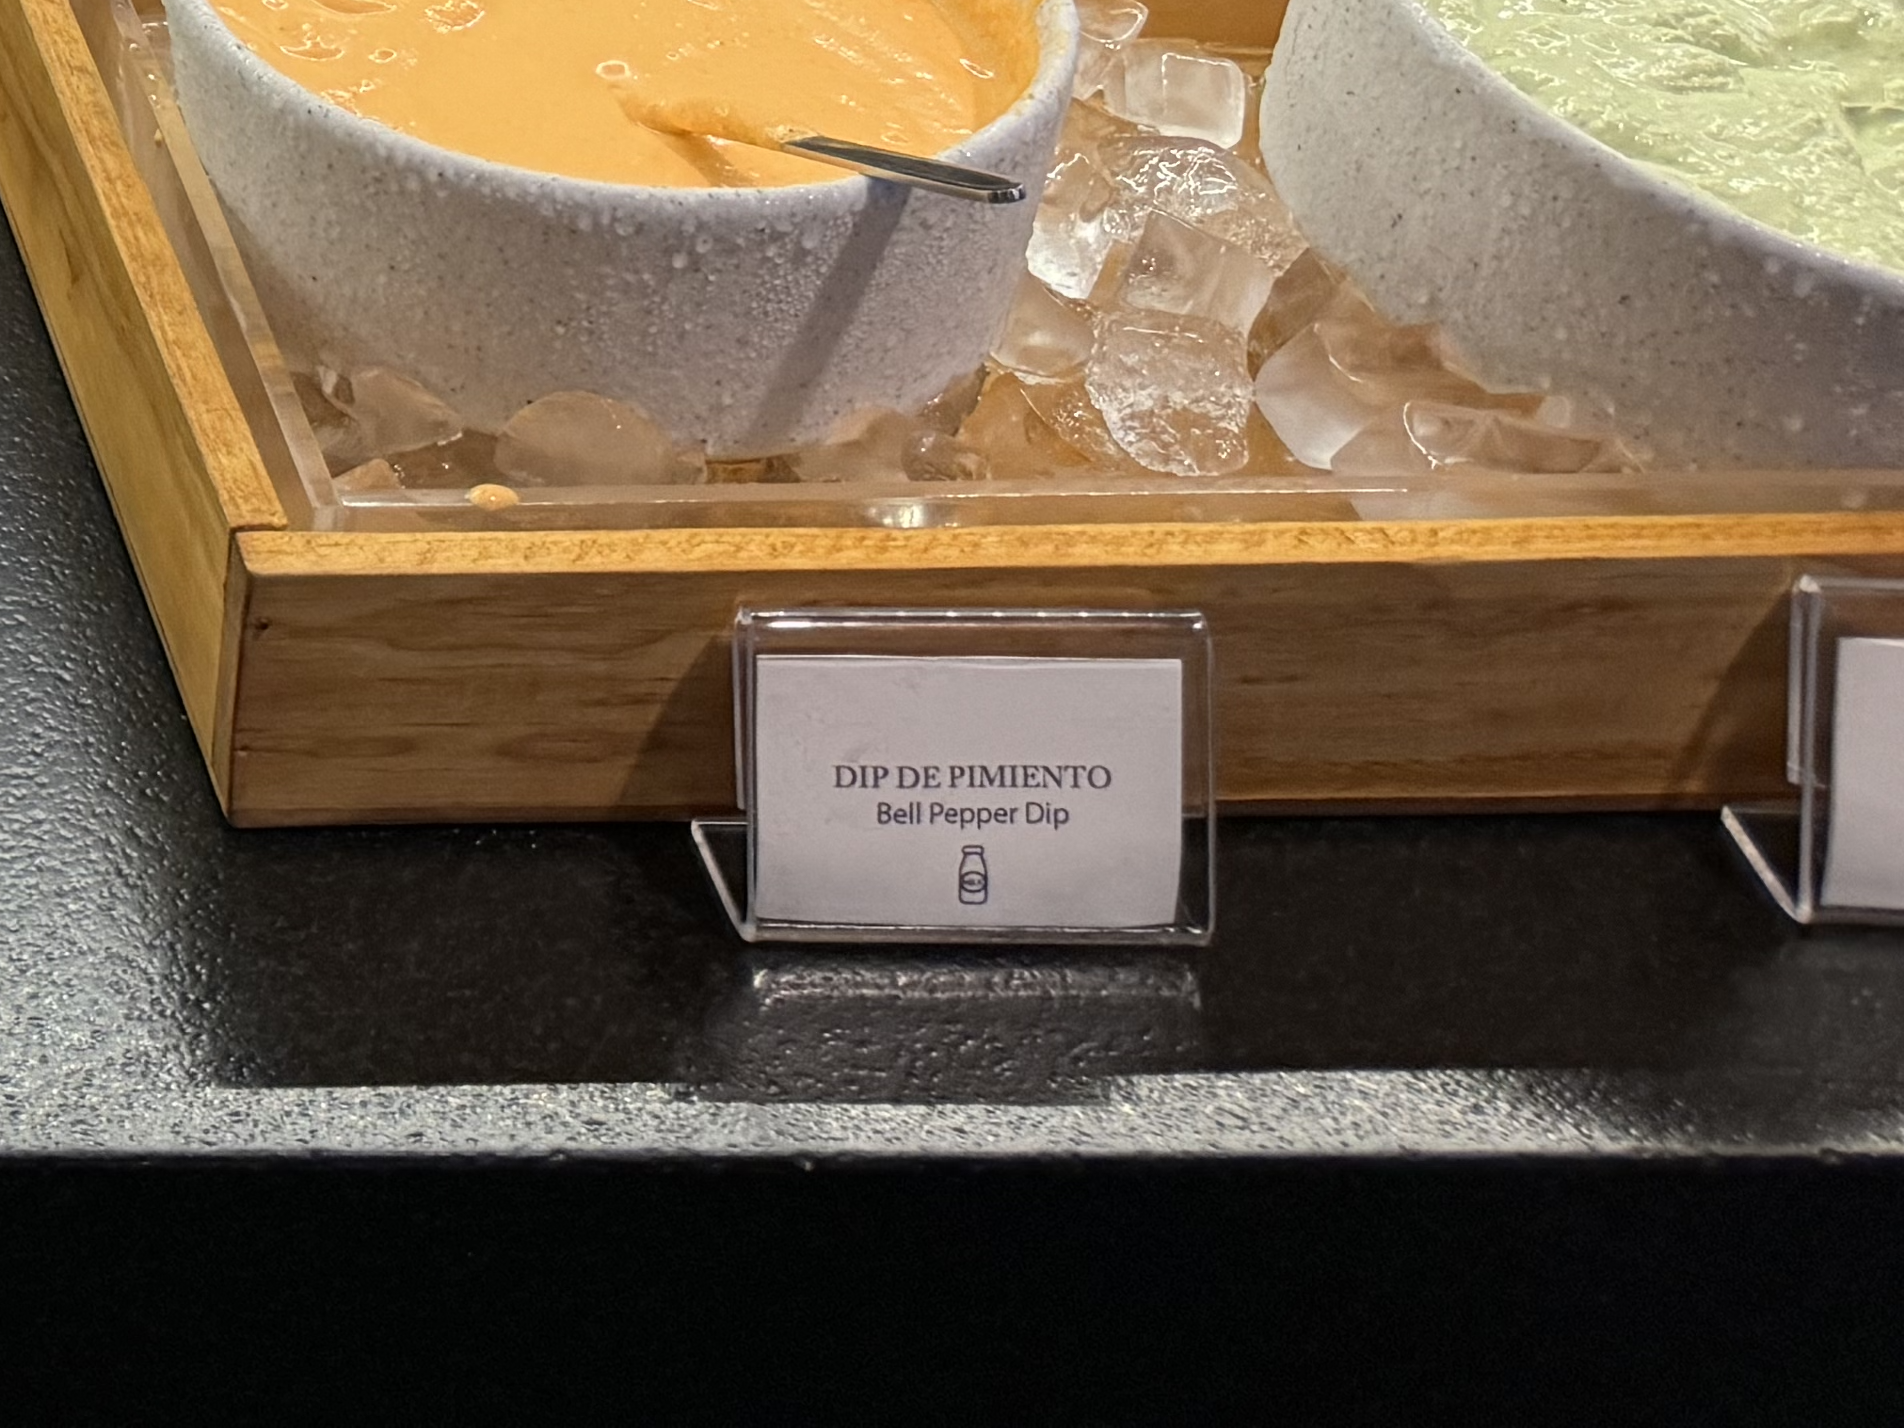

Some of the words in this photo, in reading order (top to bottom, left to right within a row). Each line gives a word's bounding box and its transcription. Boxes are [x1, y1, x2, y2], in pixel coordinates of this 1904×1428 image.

[832, 763, 890, 789] DIP
[894, 764, 942, 790] DE
[949, 763, 1113, 790] PIMIENTO
[876, 802, 922, 826] Bell
[930, 802, 1018, 831] Pepper
[1025, 802, 1070, 831] Dip
